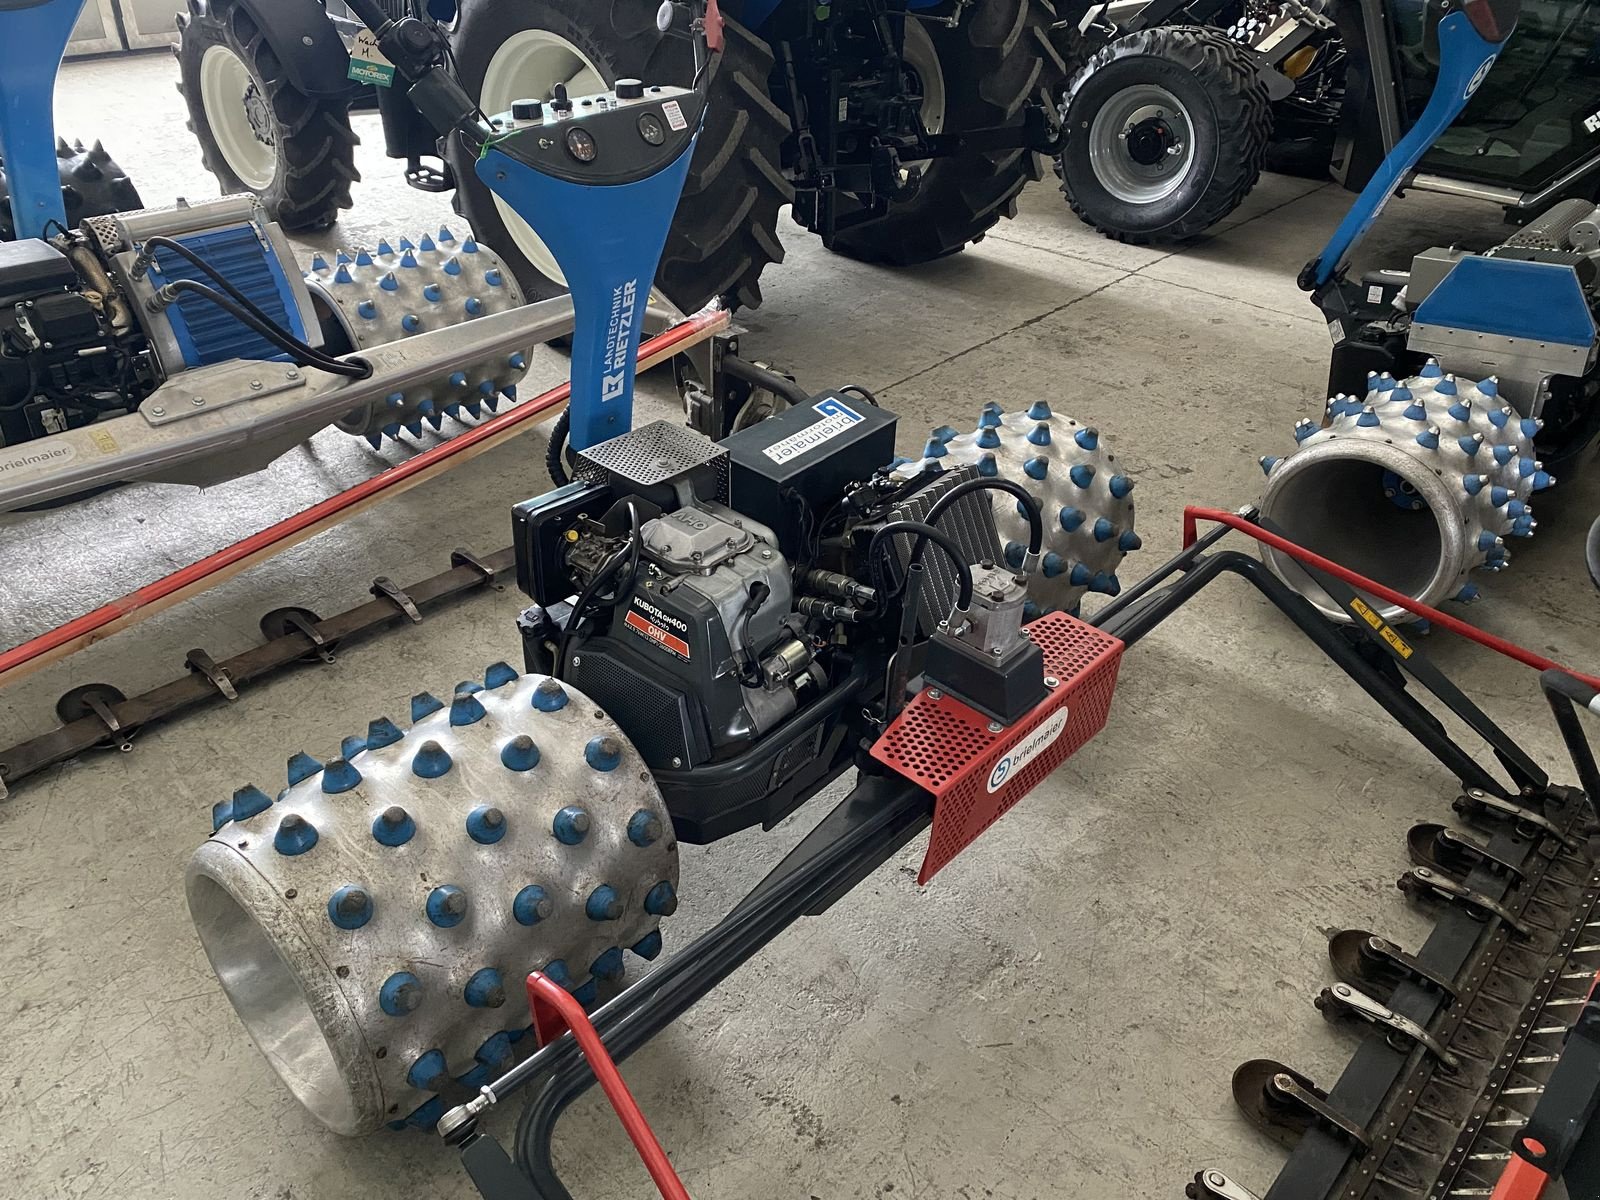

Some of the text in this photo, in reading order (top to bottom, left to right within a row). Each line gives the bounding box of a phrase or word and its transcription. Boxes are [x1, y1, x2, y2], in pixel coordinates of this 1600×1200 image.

[351, 66, 391, 84] MOTOREX
[603, 284, 623, 374] LANDTECHNIK
[613, 278, 637, 370] RIETZLER
[775, 416, 855, 460] brielmaier
[633, 596, 663, 620] KUBOTA
[647, 625, 666, 641] OHV
[1012, 718, 1063, 766] brielmaier
